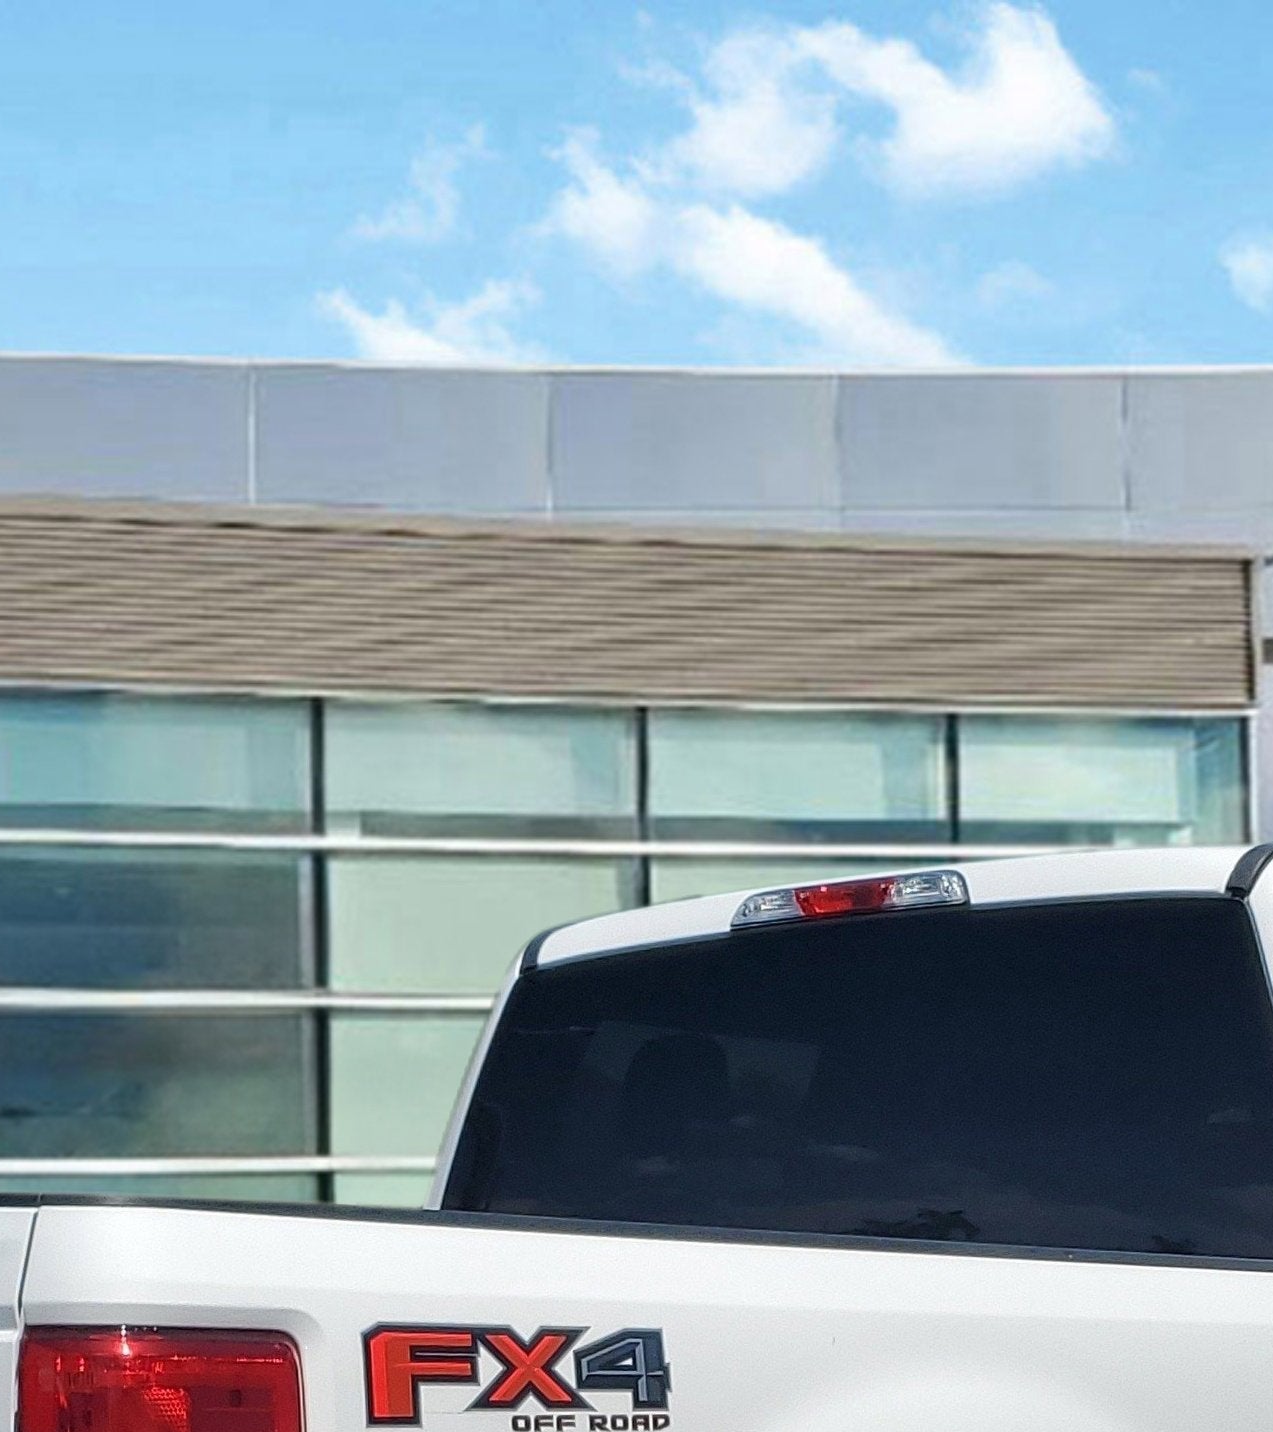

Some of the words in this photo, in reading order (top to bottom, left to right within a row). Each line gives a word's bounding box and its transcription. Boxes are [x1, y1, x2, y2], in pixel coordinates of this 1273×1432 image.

[361, 1321, 671, 1428] FX4
[511, 1414, 577, 1432] OFF
[588, 1413, 671, 1431] ROAD
